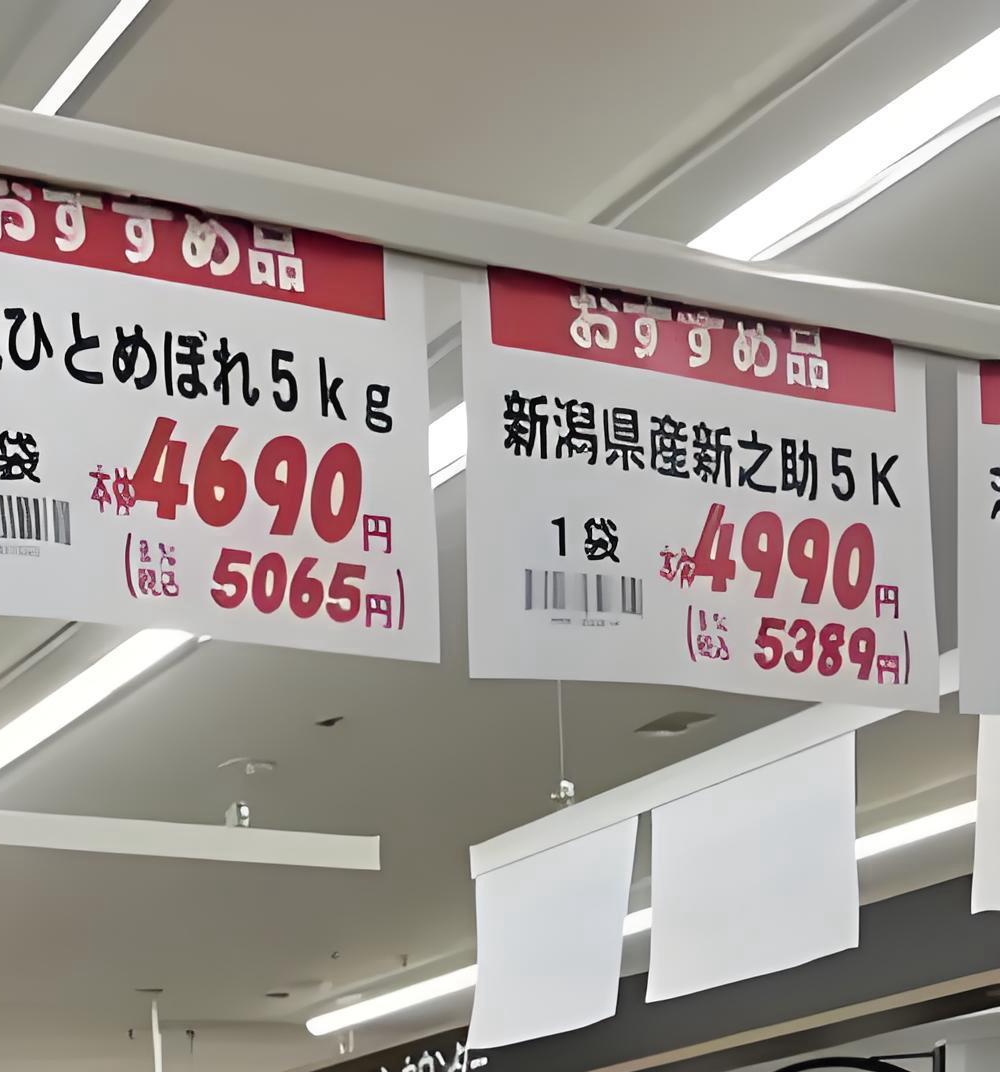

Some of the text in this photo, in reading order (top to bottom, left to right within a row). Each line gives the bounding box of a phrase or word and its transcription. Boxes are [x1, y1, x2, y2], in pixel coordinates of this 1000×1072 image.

[568, 286, 830, 390] おすすめ品
